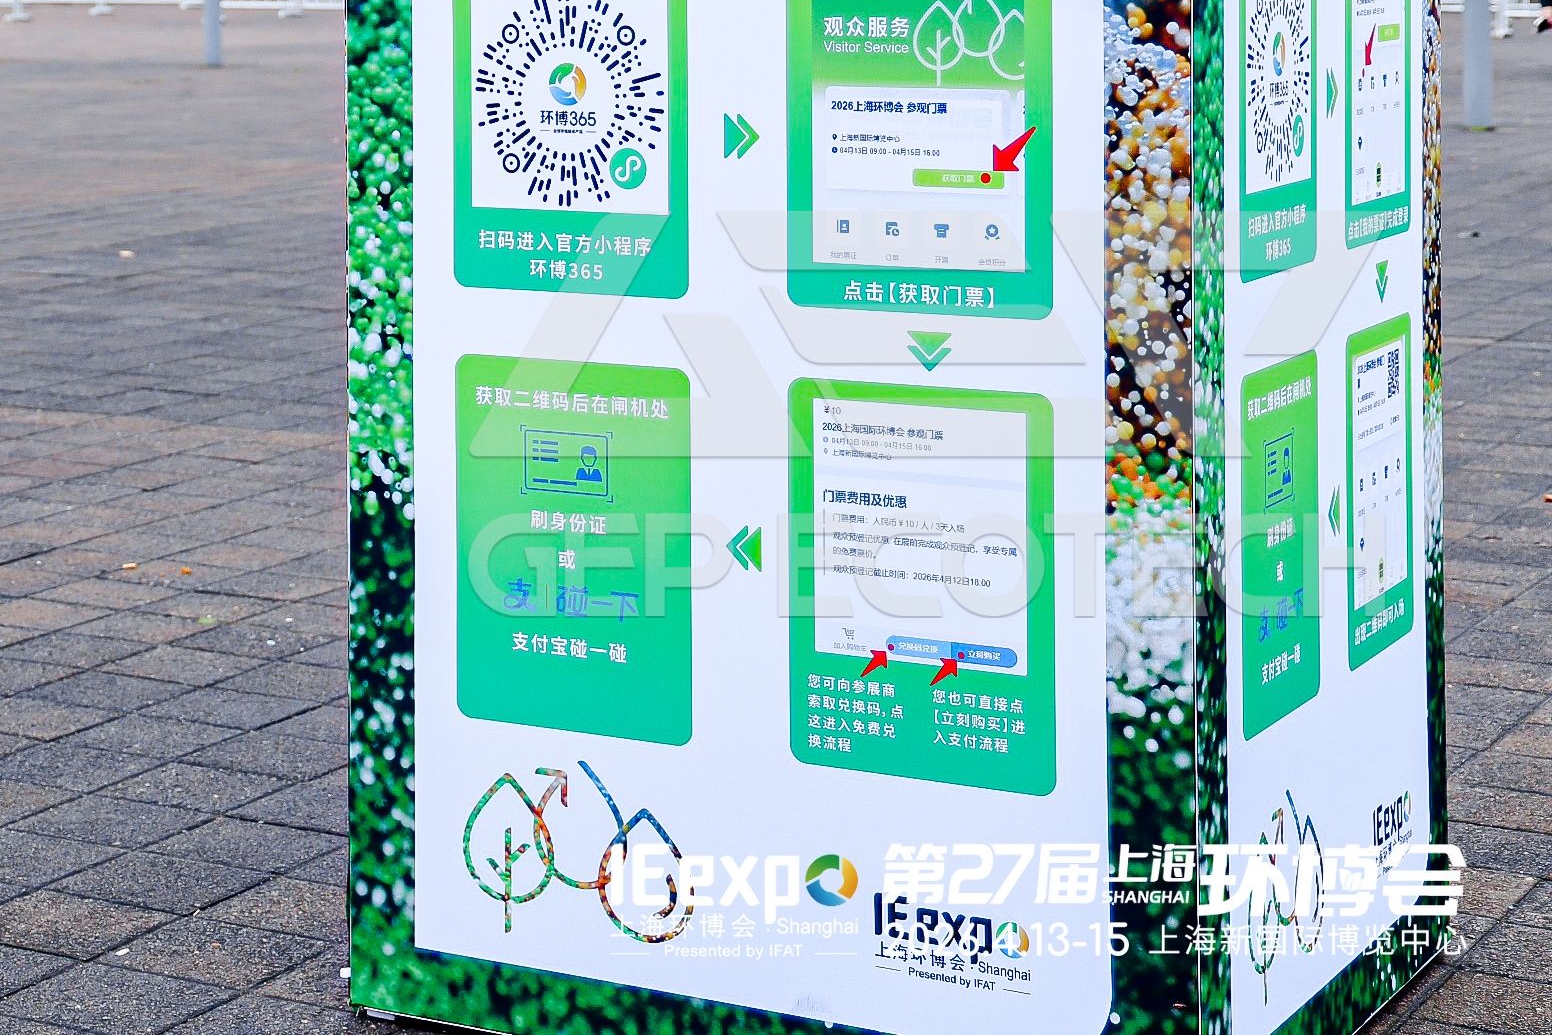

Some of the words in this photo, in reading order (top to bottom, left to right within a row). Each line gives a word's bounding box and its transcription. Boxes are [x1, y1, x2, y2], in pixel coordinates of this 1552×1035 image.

[823, 16, 910, 38] 观众服务
[823, 41, 860, 53] Visitor
[864, 41, 909, 54] Service
[540, 110, 597, 126] 环博365
[831, 100, 903, 113] 2026上海环博会
[907, 102, 947, 114] 参观门票
[1247, 203, 1307, 238] 扫码进入官方小程序
[478, 228, 652, 257] 扫码进入官方小程序
[1265, 239, 1291, 262] 环博365
[529, 259, 603, 281] 环博365
[843, 280, 995, 309] 点击【获取门票】
[475, 385, 670, 420] 获取二维码后在闸机处
[823, 489, 907, 508] 门票费用及优惠
[530, 509, 607, 536] 刷身份证
[558, 550, 576, 570] 或
[1276, 561, 1284, 582] 或
[556, 585, 640, 623] 碰一下
[511, 631, 628, 664] 支付宝碰一碰
[1261, 644, 1301, 686] 支付宝碰一碰
[807, 673, 895, 698] 您可向参展商
[932, 689, 1024, 714] 您也可直接点
[807, 714, 896, 739] 这进入免费兑
[934, 709, 1026, 735] 【立刻购买】进
[808, 734, 852, 753] 换流程
[933, 730, 1009, 753] 入支付流程
[908, 967, 957, 984] Presented
[960, 975, 971, 989] by
[974, 978, 996, 991] IFAT
[978, 961, 1031, 982] Shanghai
